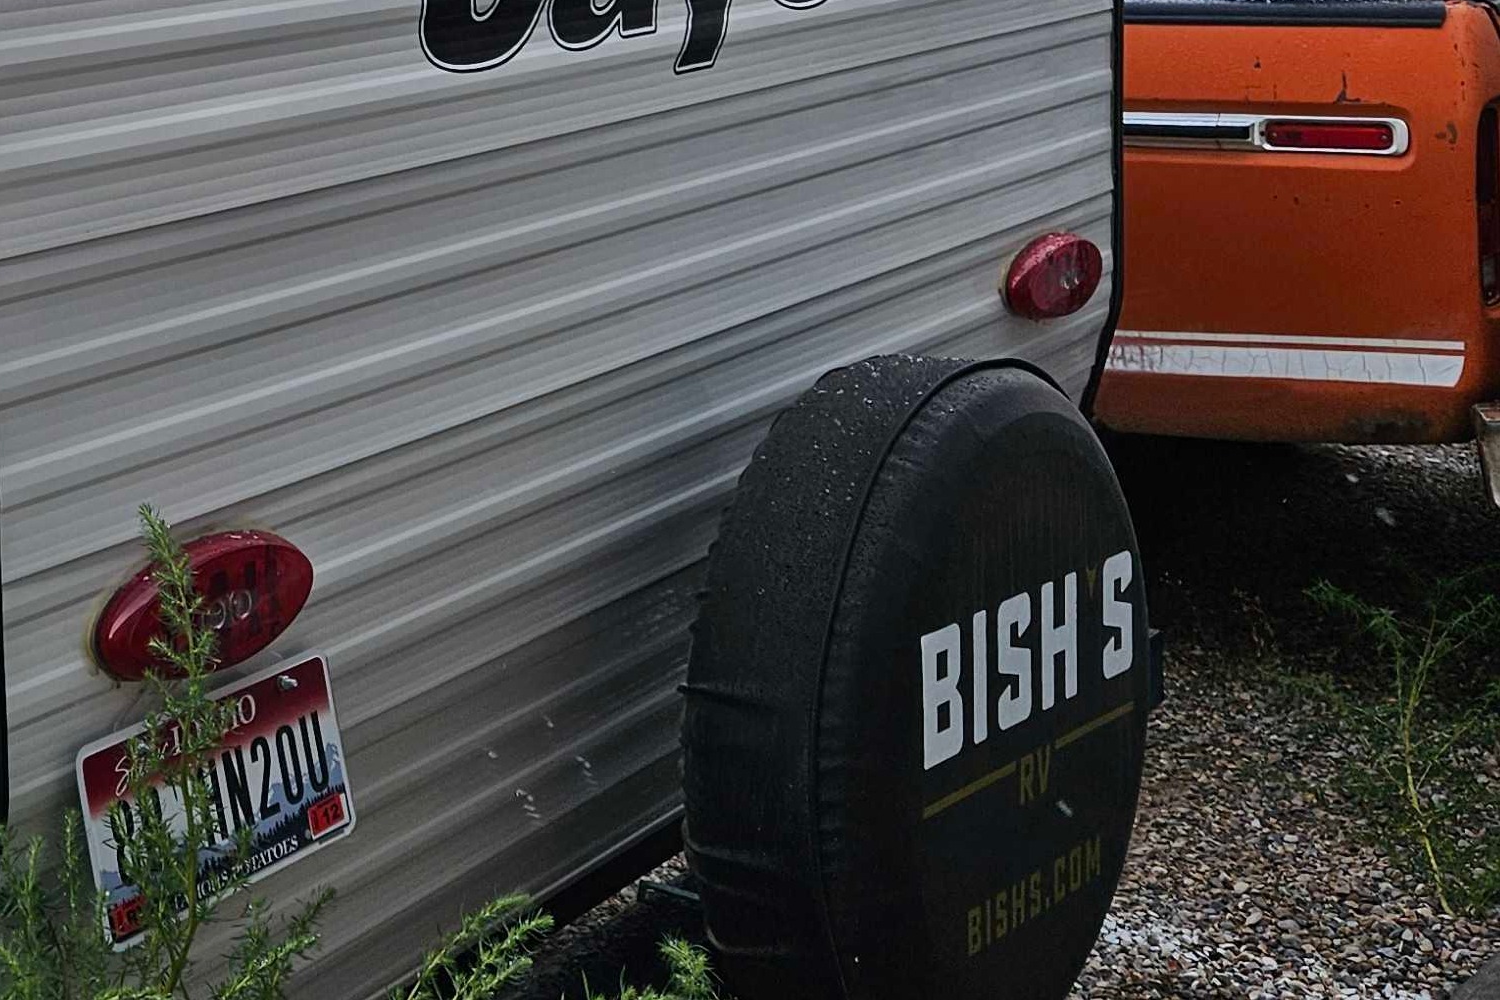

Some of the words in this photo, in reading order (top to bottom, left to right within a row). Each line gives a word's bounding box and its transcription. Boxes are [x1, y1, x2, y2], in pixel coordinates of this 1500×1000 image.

[921, 550, 1133, 770] BISH'S
[1019, 745, 1051, 806] RV
[967, 835, 1101, 957] BISHS.COM
